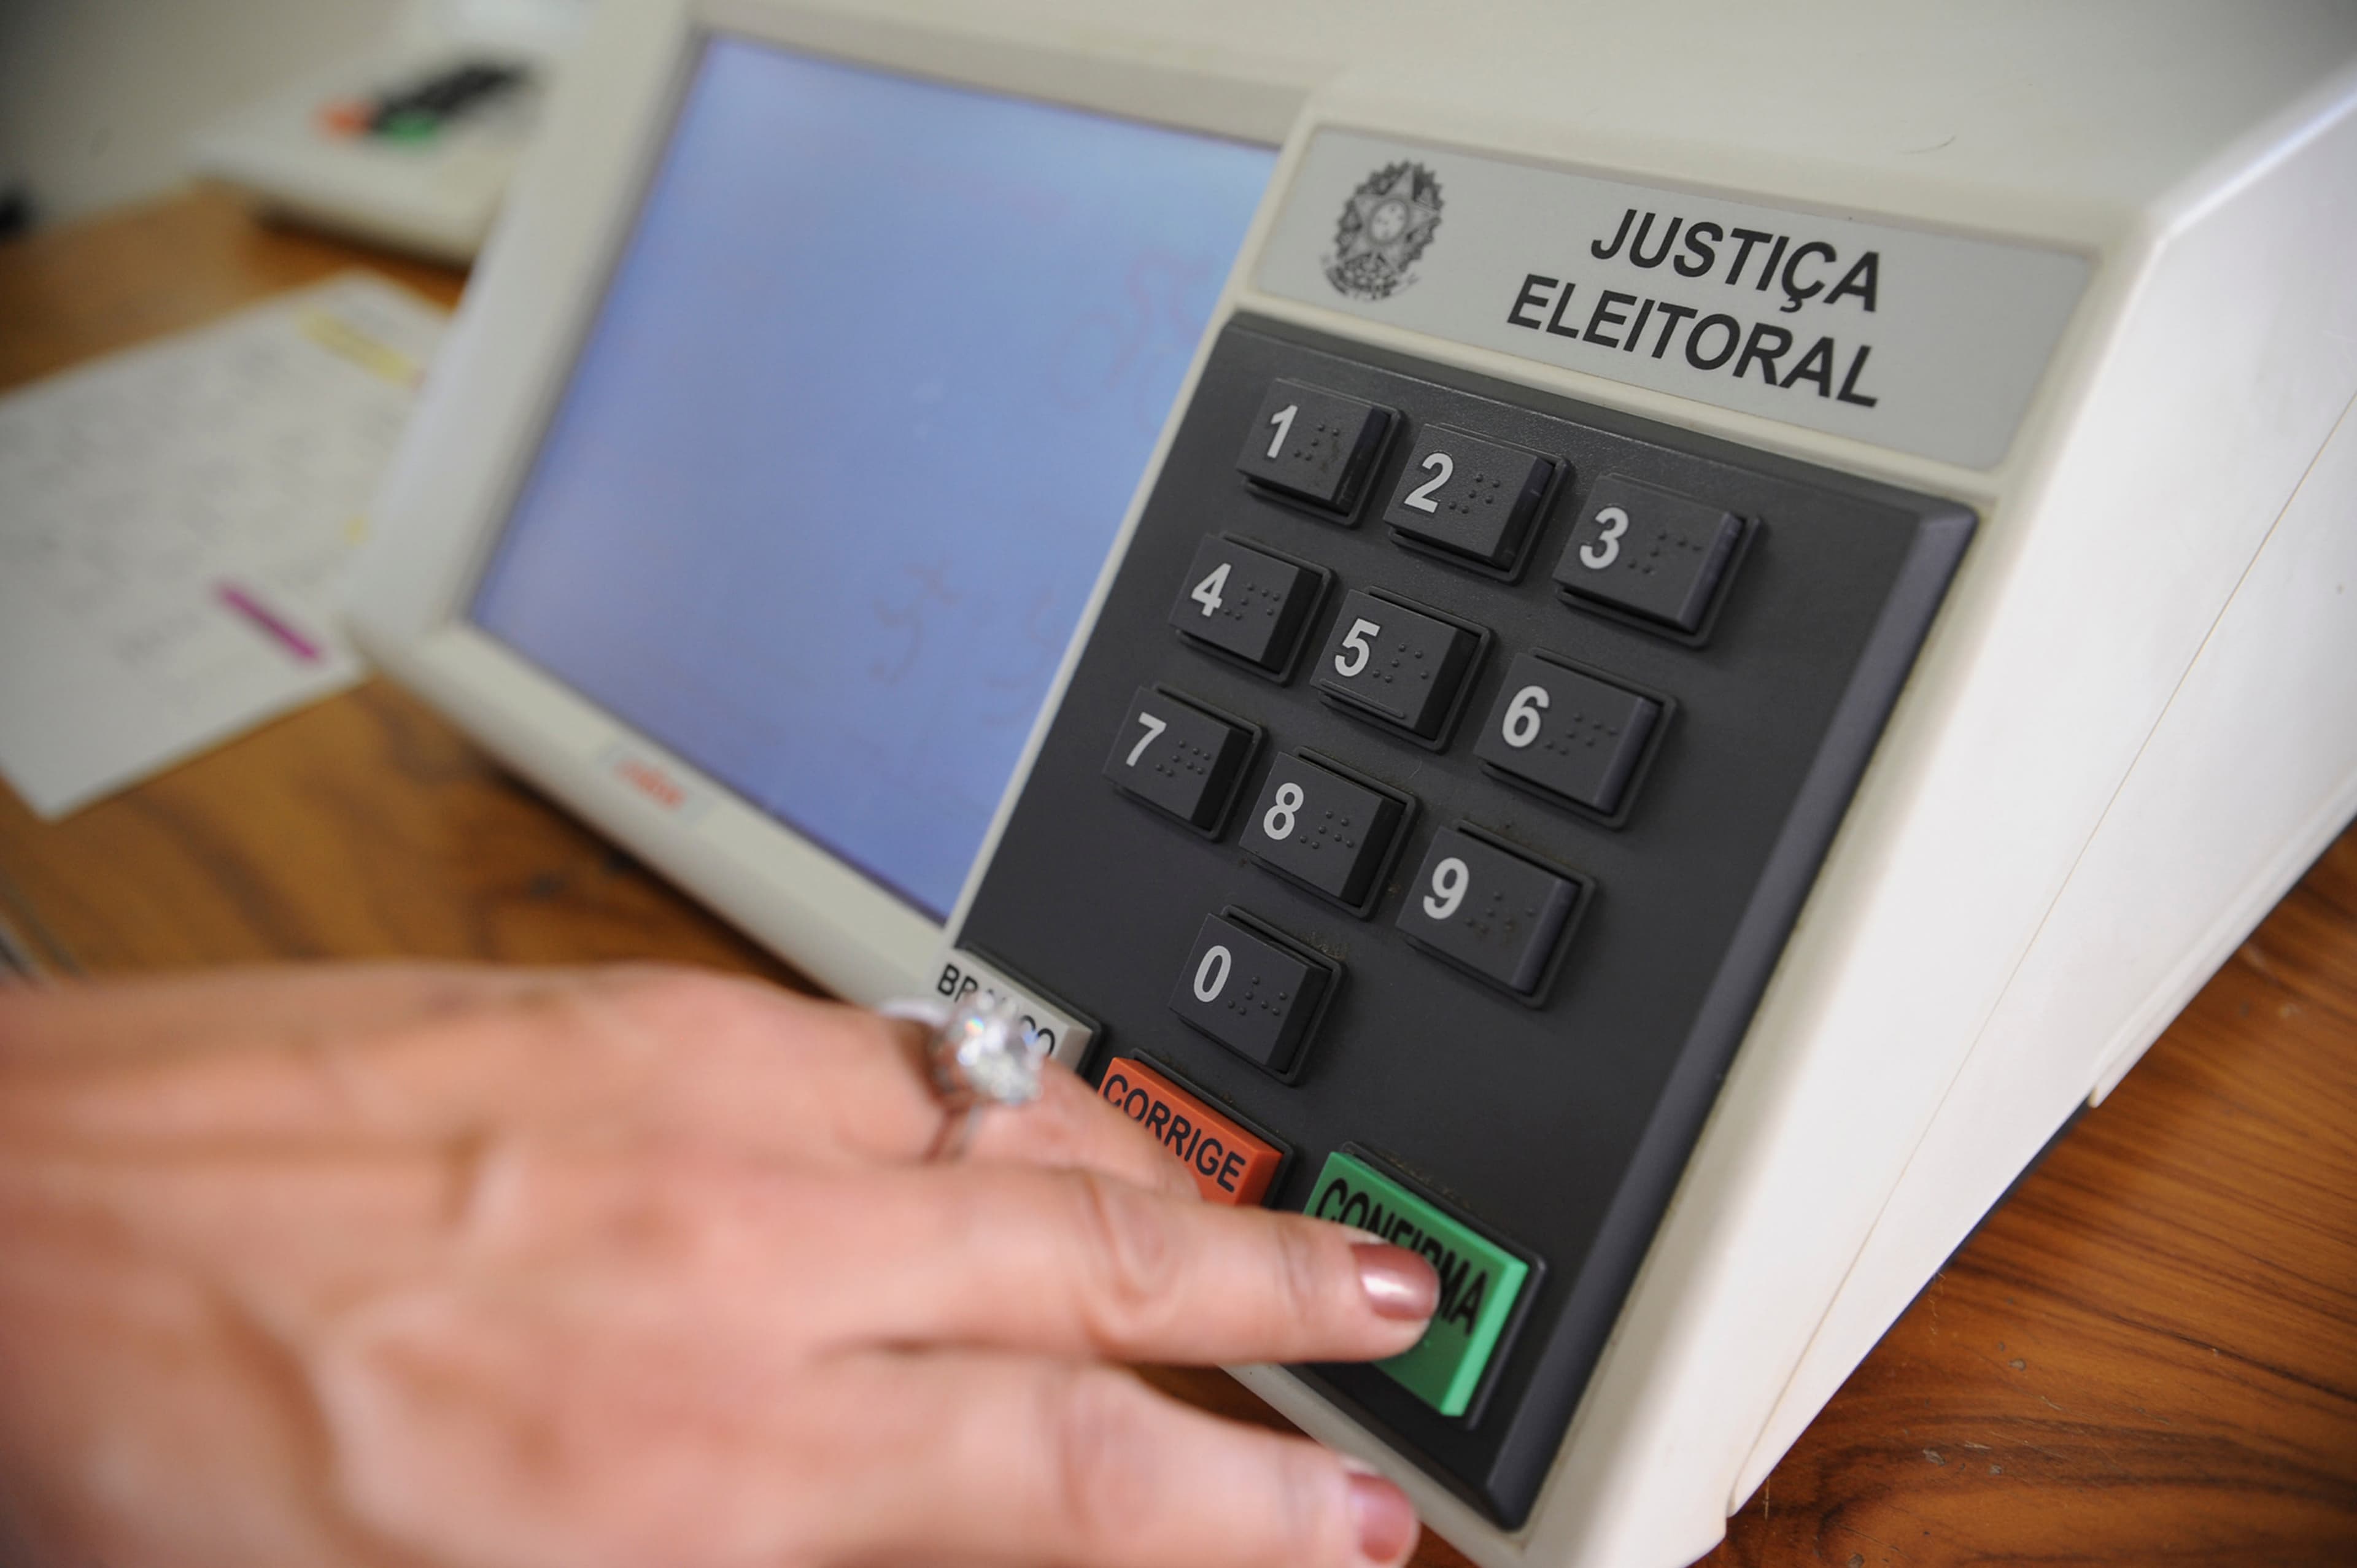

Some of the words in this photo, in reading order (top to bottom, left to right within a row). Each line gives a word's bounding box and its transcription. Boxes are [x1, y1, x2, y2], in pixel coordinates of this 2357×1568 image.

[1591, 208, 1879, 314] JUSTIÇA
[1507, 273, 1878, 408] ELEITORAL
[1267, 404, 1298, 458] 1
[1404, 452, 1453, 513] 2
[1579, 507, 1628, 569] 3
[1191, 563, 1231, 617] 4
[1334, 618, 1380, 677] 5
[1126, 712, 1167, 767] 7
[1503, 686, 1549, 747] 6
[1263, 782, 1304, 840] 8
[1423, 857, 1469, 919] 9
[1193, 945, 1231, 1002] 0
[937, 963, 1056, 1057] BRO
[1102, 1073, 1246, 1193] CORRIGE
